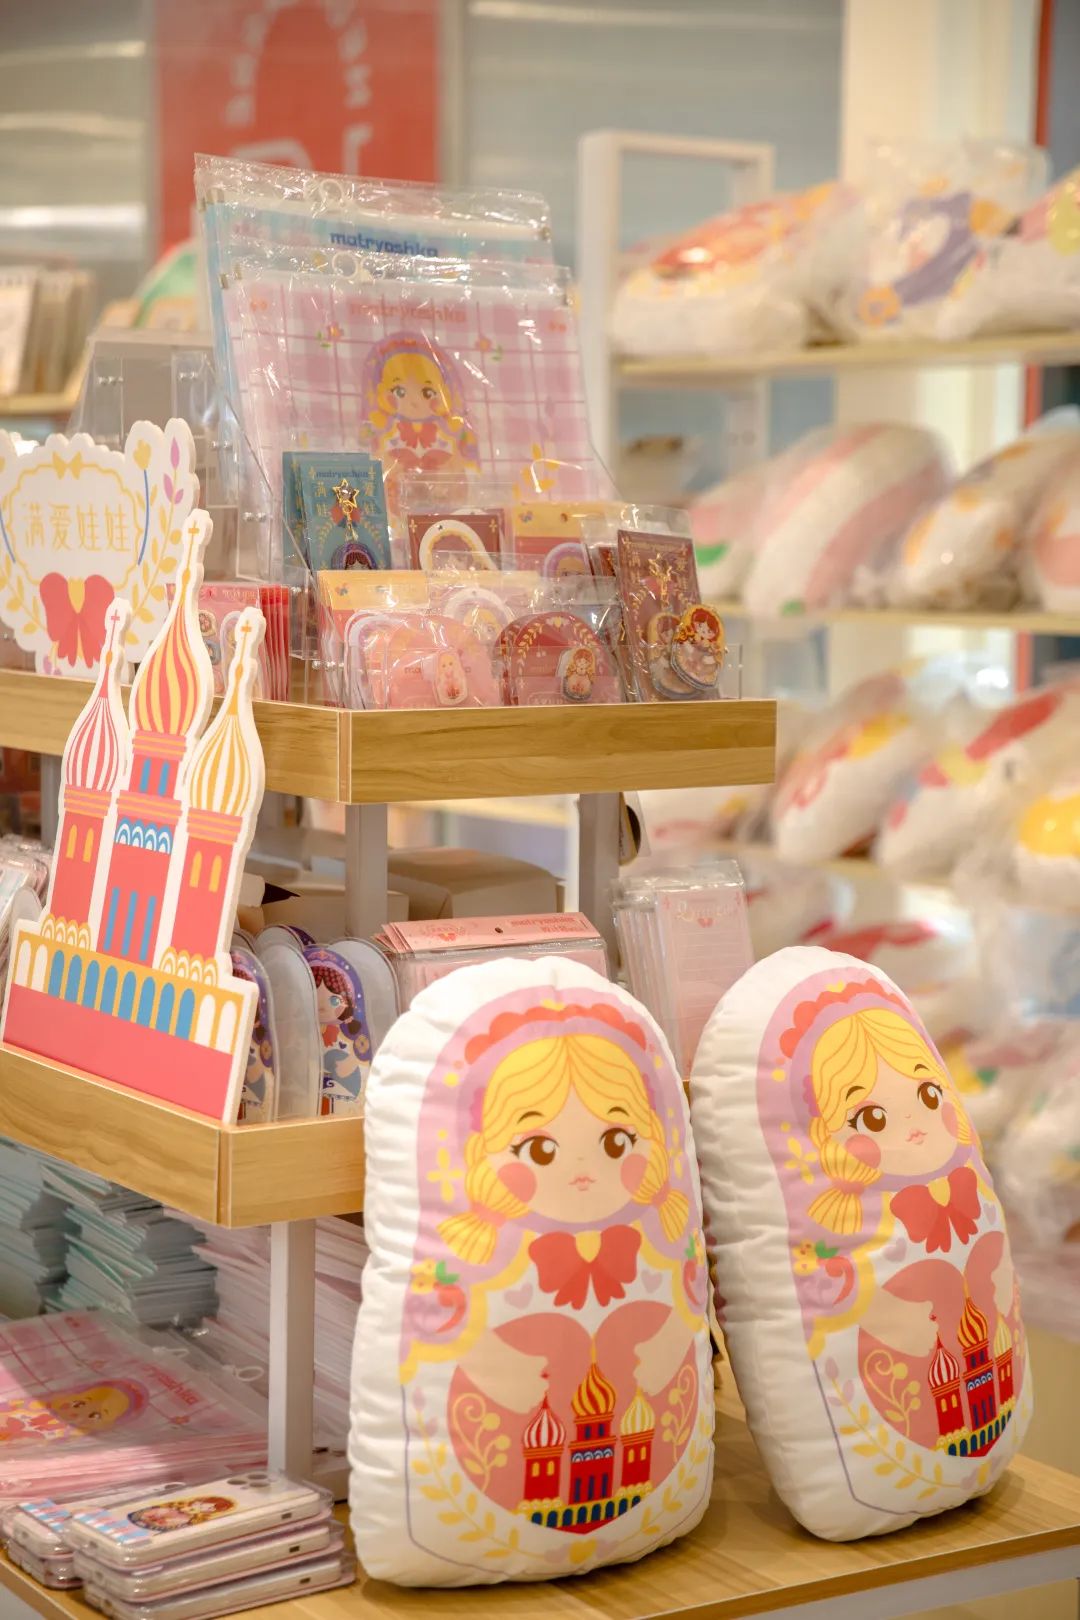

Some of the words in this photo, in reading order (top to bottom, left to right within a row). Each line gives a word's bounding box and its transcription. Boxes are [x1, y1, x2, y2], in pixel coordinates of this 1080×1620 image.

[330, 231, 439, 257] matryoshka
[21, 500, 132, 552] 满爱娃娃
